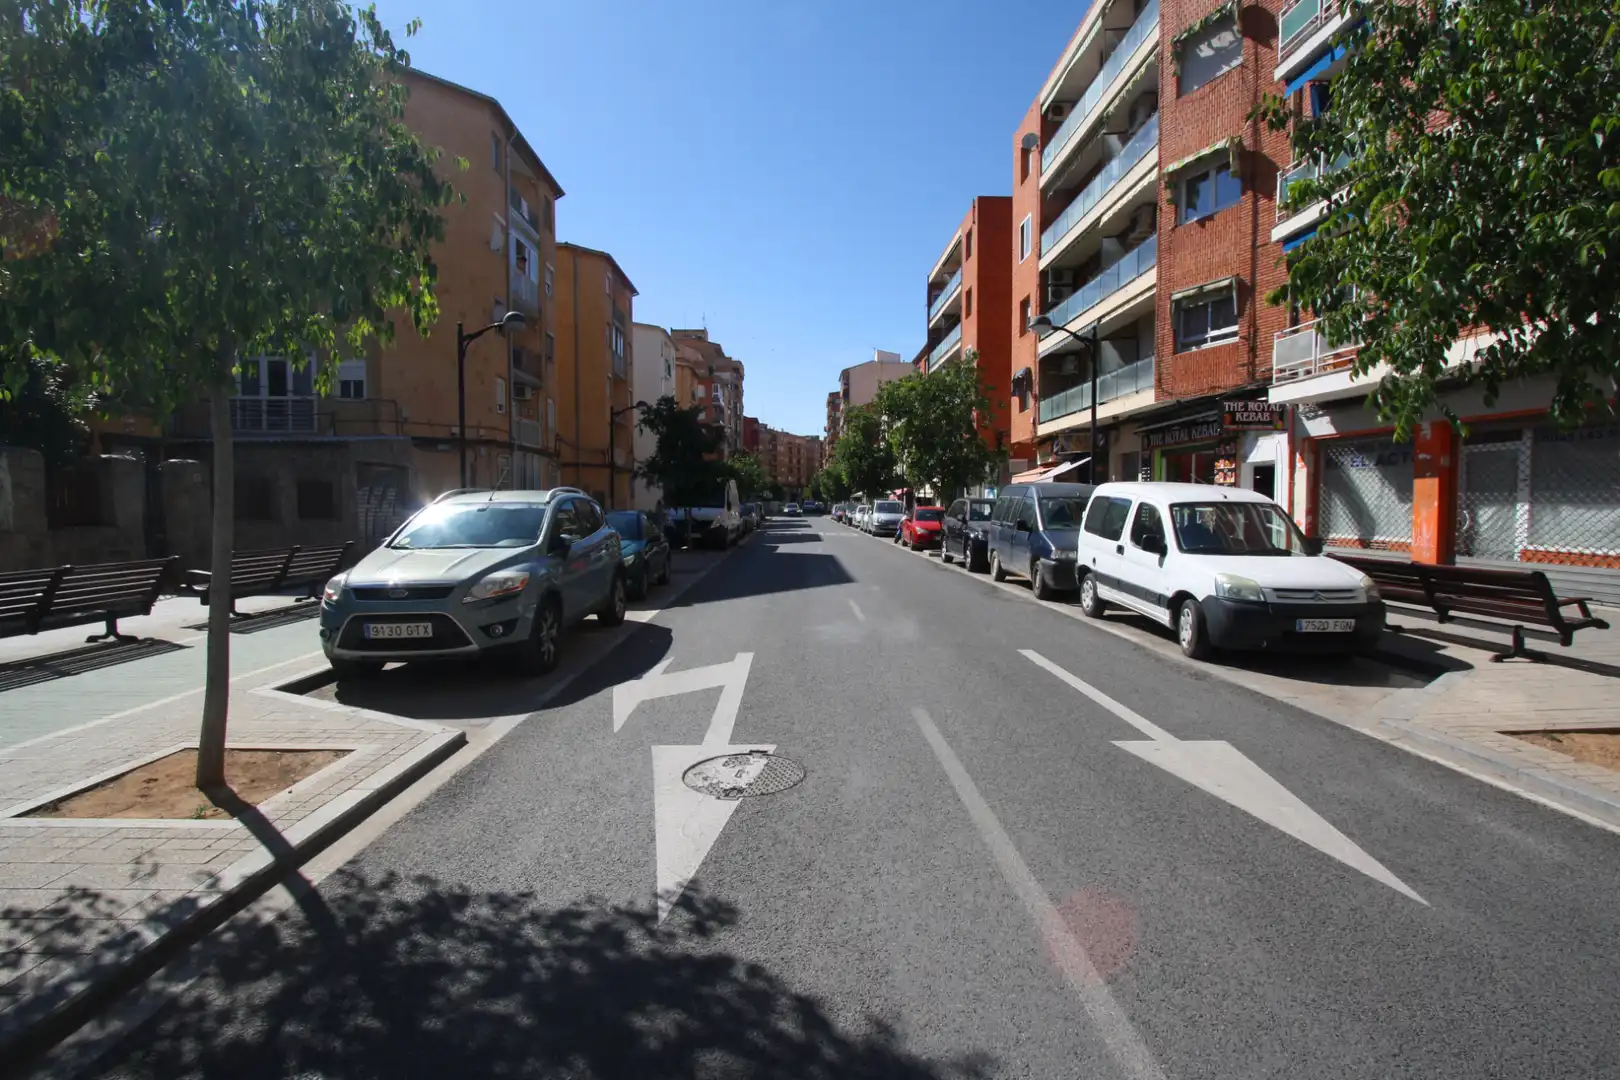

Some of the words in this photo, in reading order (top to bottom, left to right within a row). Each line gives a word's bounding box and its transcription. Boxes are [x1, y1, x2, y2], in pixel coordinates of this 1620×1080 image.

[1223, 402, 1245, 412] THE
[1248, 402, 1283, 412] ROYAL
[1235, 412, 1270, 422] KEBAB
[371, 625, 402, 637] 9130
[406, 624, 430, 636] GTX
[1304, 620, 1330, 631] 7520
[1332, 620, 1353, 631] FGN
